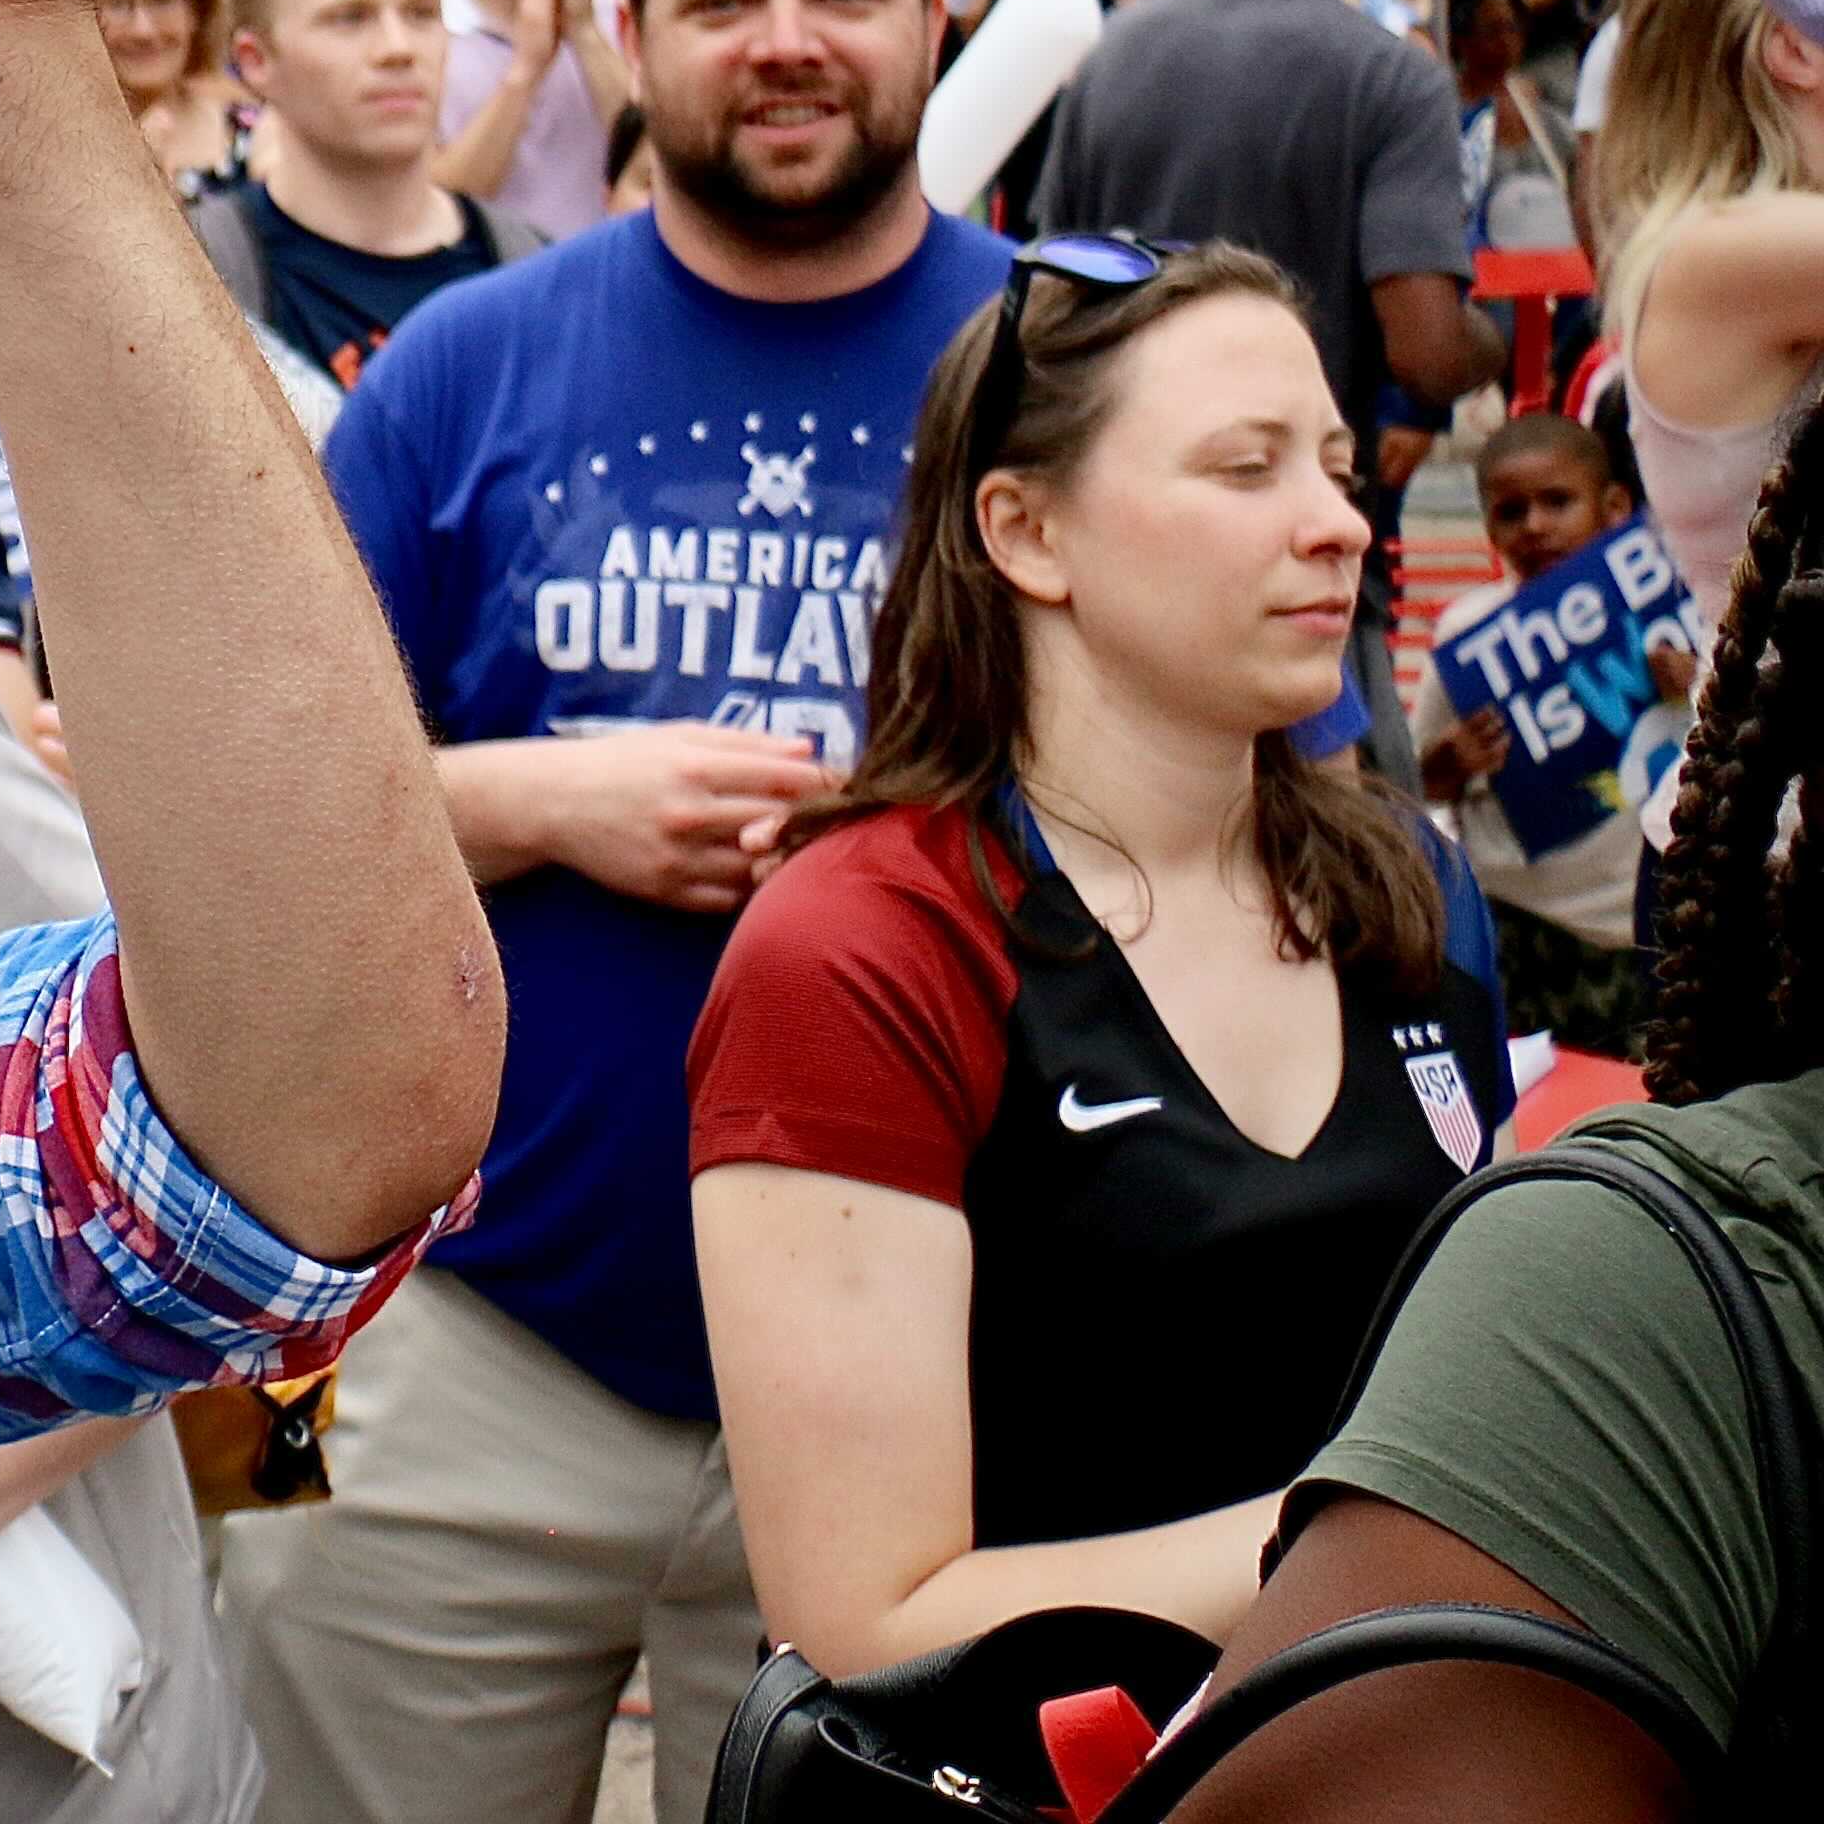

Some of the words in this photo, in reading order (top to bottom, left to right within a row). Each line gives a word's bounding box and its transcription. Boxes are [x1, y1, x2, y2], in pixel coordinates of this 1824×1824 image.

[600, 524, 891, 592] AMERICA
[534, 577, 872, 688] OUTLA
[1454, 582, 1609, 700] The
[1508, 684, 1587, 765] Is
